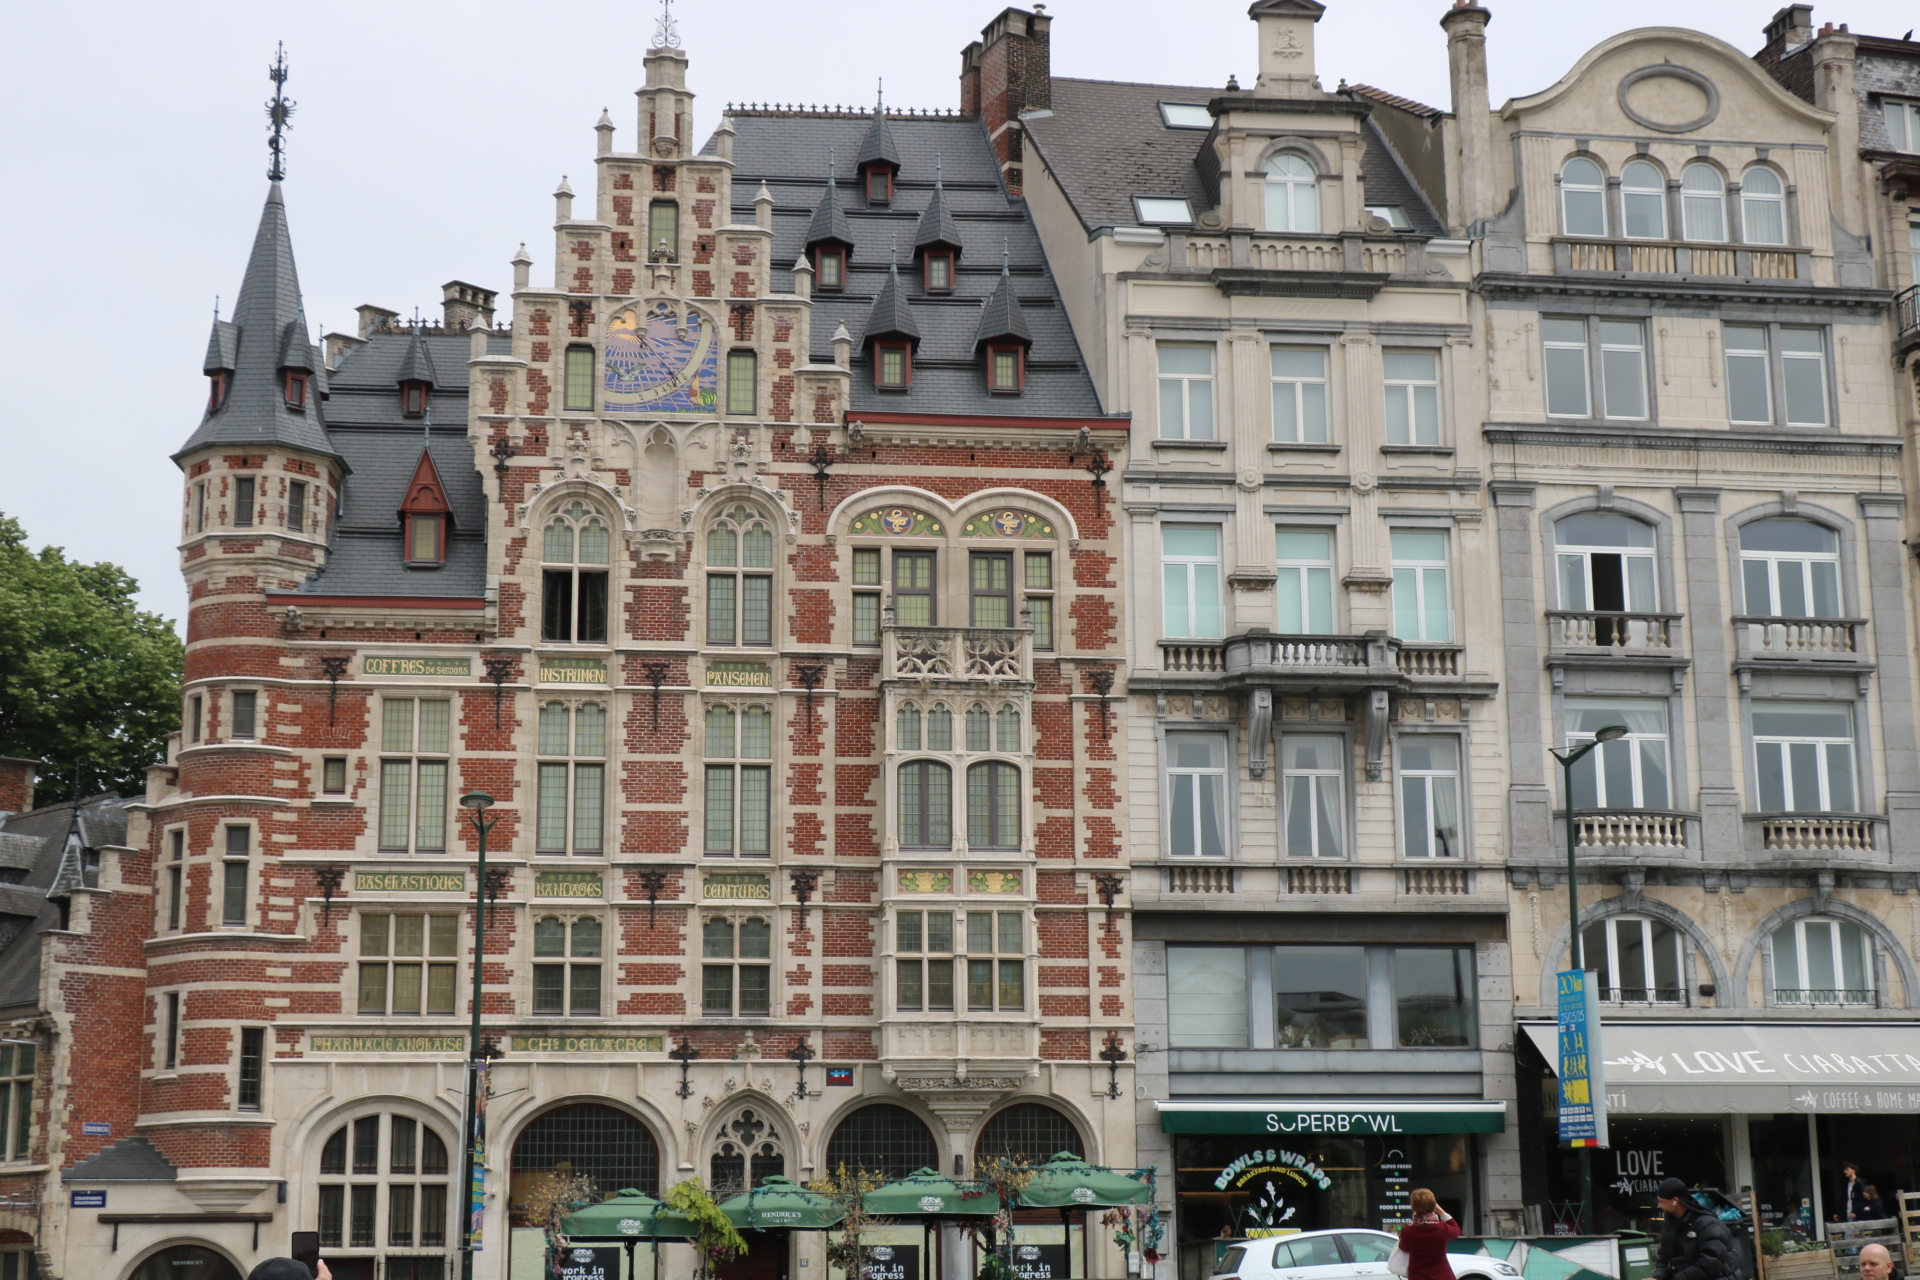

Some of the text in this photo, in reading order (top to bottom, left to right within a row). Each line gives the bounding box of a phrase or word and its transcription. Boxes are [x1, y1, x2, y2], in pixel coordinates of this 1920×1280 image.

[366, 659, 424, 674] COFFRES
[436, 666, 469, 675] SECOURS
[357, 875, 383, 890] BAS
[536, 883, 602, 898] BANDAGES
[704, 884, 770, 899] CEINTURES
[313, 1037, 393, 1051] PHARMACIE
[566, 1038, 647, 1051] DELACRE
[1671, 1050, 1776, 1074] LOVE
[1823, 1091, 1860, 1109] COFFEE
[1864, 1094, 1872, 1107] &
[1877, 1091, 1904, 1109] HOME
[1266, 1113, 1402, 1132] SUPERBOWL
[1214, 1149, 1331, 1190] BOWLS & WRAPS
[1616, 1150, 1664, 1175] LOVE
[1236, 1166, 1270, 1188] BREAKFAST
[1286, 1170, 1308, 1188] LUNCH
[592, 1266, 604, 1274] in
[892, 1264, 904, 1272] in
[1039, 1263, 1050, 1271] in
